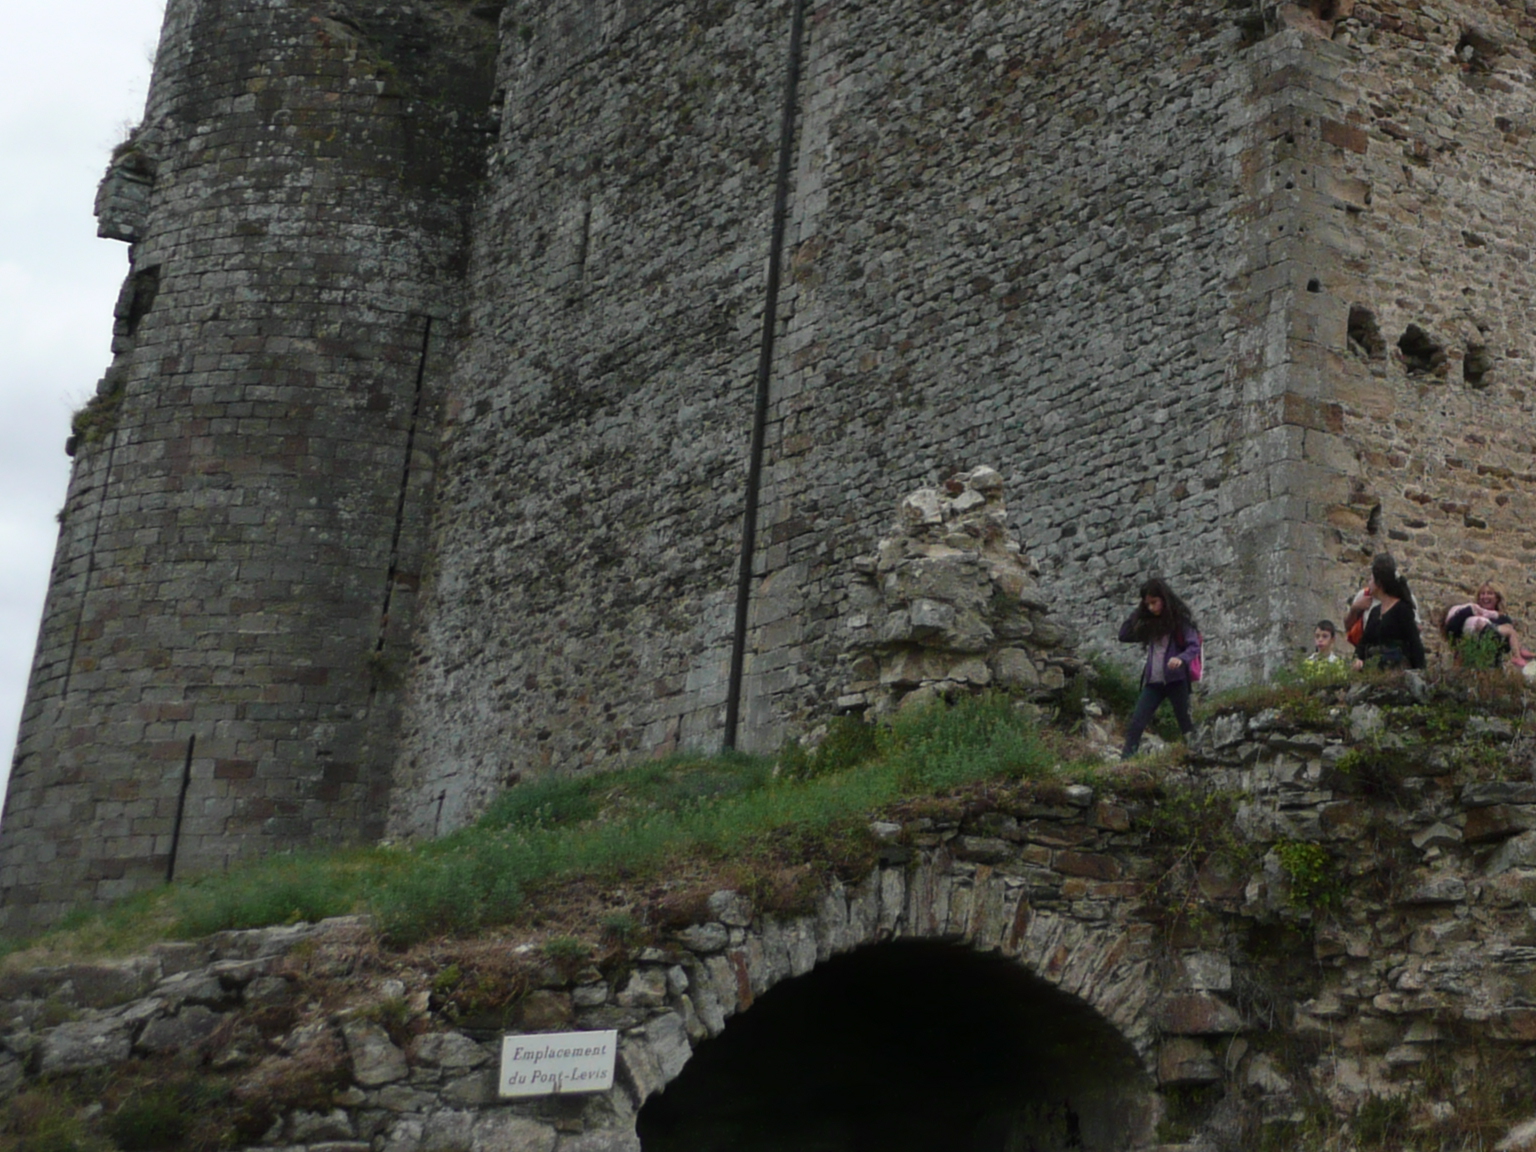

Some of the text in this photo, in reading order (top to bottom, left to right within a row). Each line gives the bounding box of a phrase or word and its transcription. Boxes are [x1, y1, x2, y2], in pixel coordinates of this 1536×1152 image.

[513, 1045, 607, 1064] Emplacement
[508, 1067, 608, 1085] du Pont-Levis
